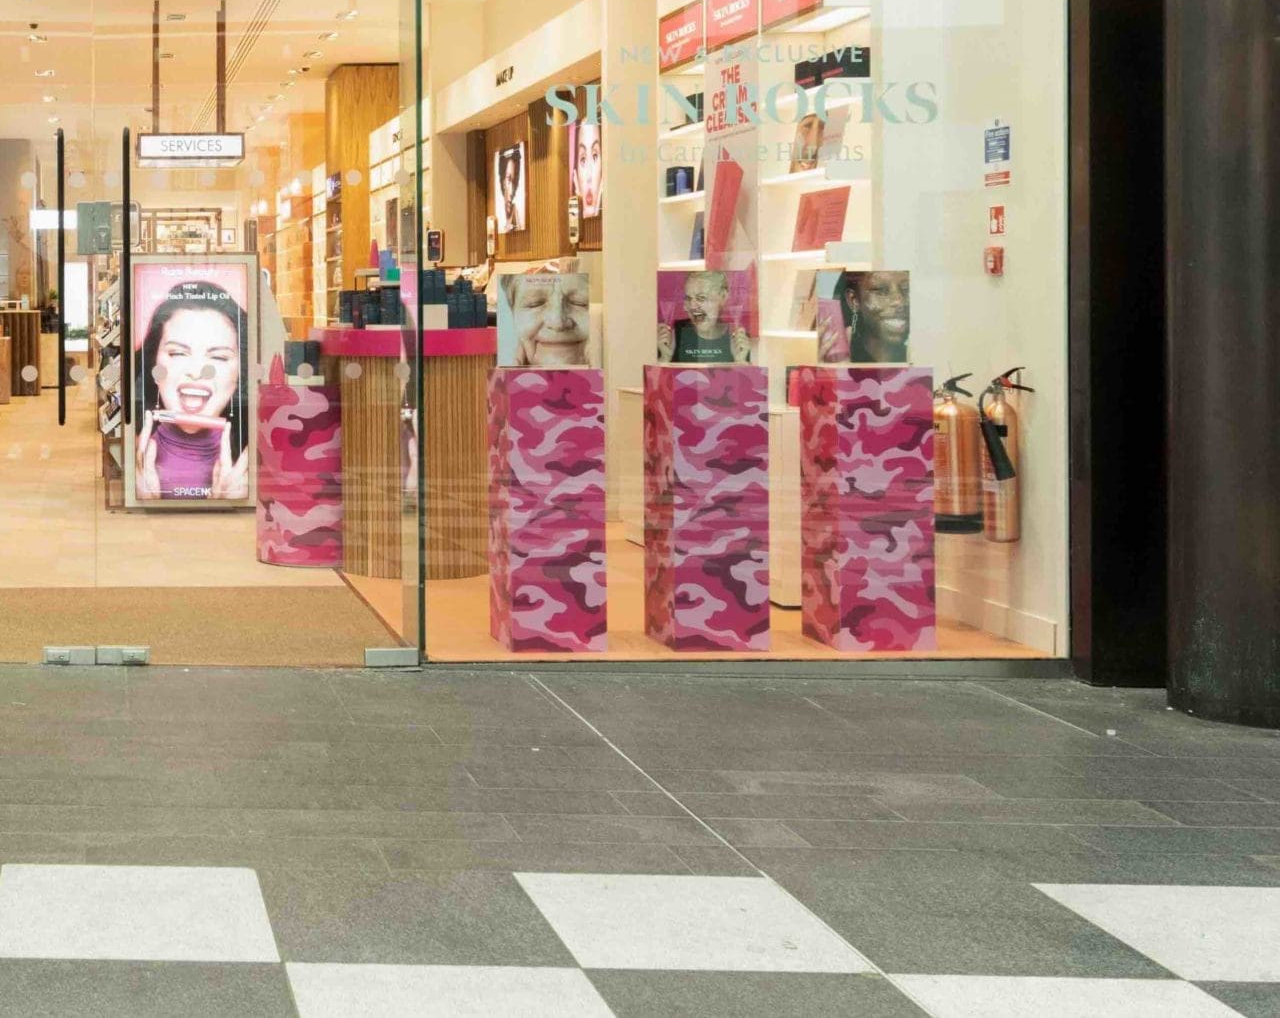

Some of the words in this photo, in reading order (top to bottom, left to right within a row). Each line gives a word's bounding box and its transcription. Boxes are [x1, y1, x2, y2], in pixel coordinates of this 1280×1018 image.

[723, 44, 863, 64] EXCLUSIVE
[721, 64, 740, 87] THE
[545, 83, 704, 126] SKIN
[721, 81, 939, 126] ROCKS
[161, 139, 223, 152] SERVICES
[185, 292, 206, 300] Tinted
[207, 292, 218, 301] Lip
